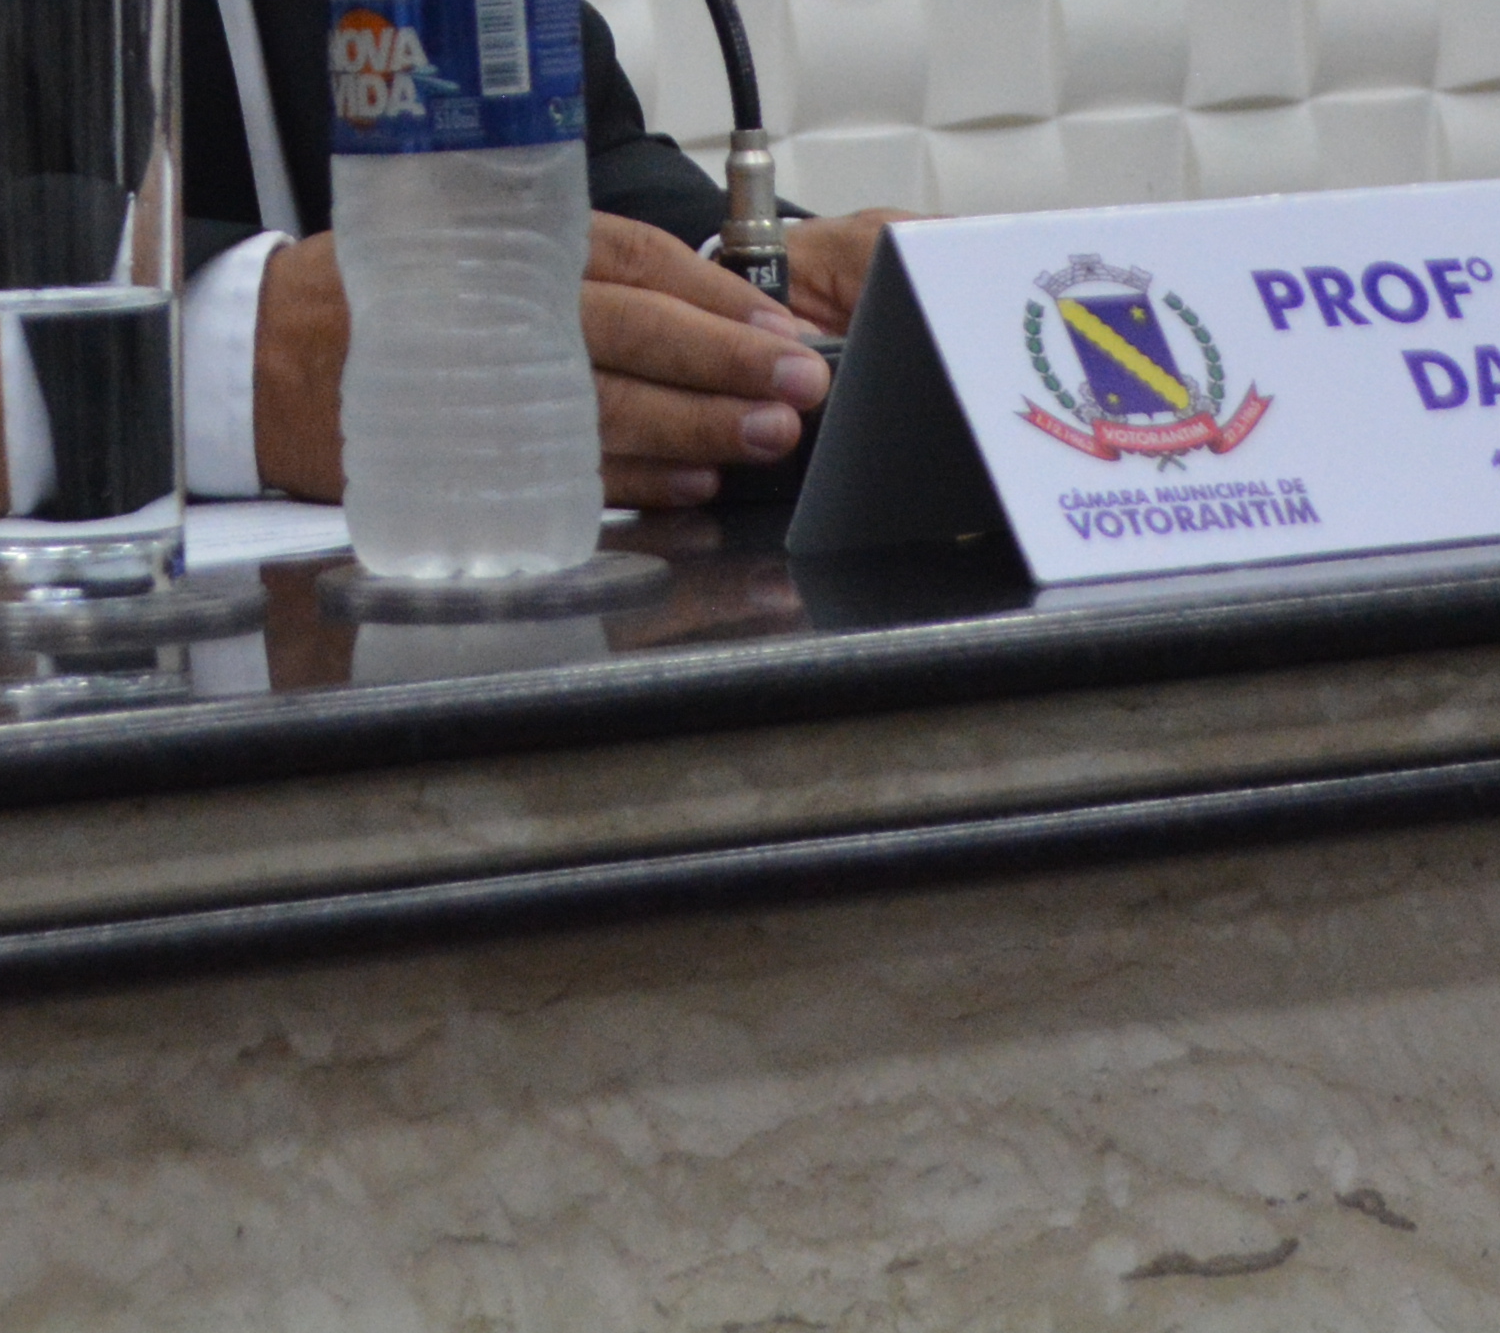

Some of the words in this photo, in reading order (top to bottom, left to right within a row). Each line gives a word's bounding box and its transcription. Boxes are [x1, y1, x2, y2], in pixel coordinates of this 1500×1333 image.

[1103, 421, 1209, 446] VOTORANTIM
[1059, 487, 1151, 511] CÂMARA
[1155, 480, 1274, 501] MUNICIPAL
[1277, 477, 1307, 495] DE
[1064, 497, 1319, 540] VOTORANTIM
